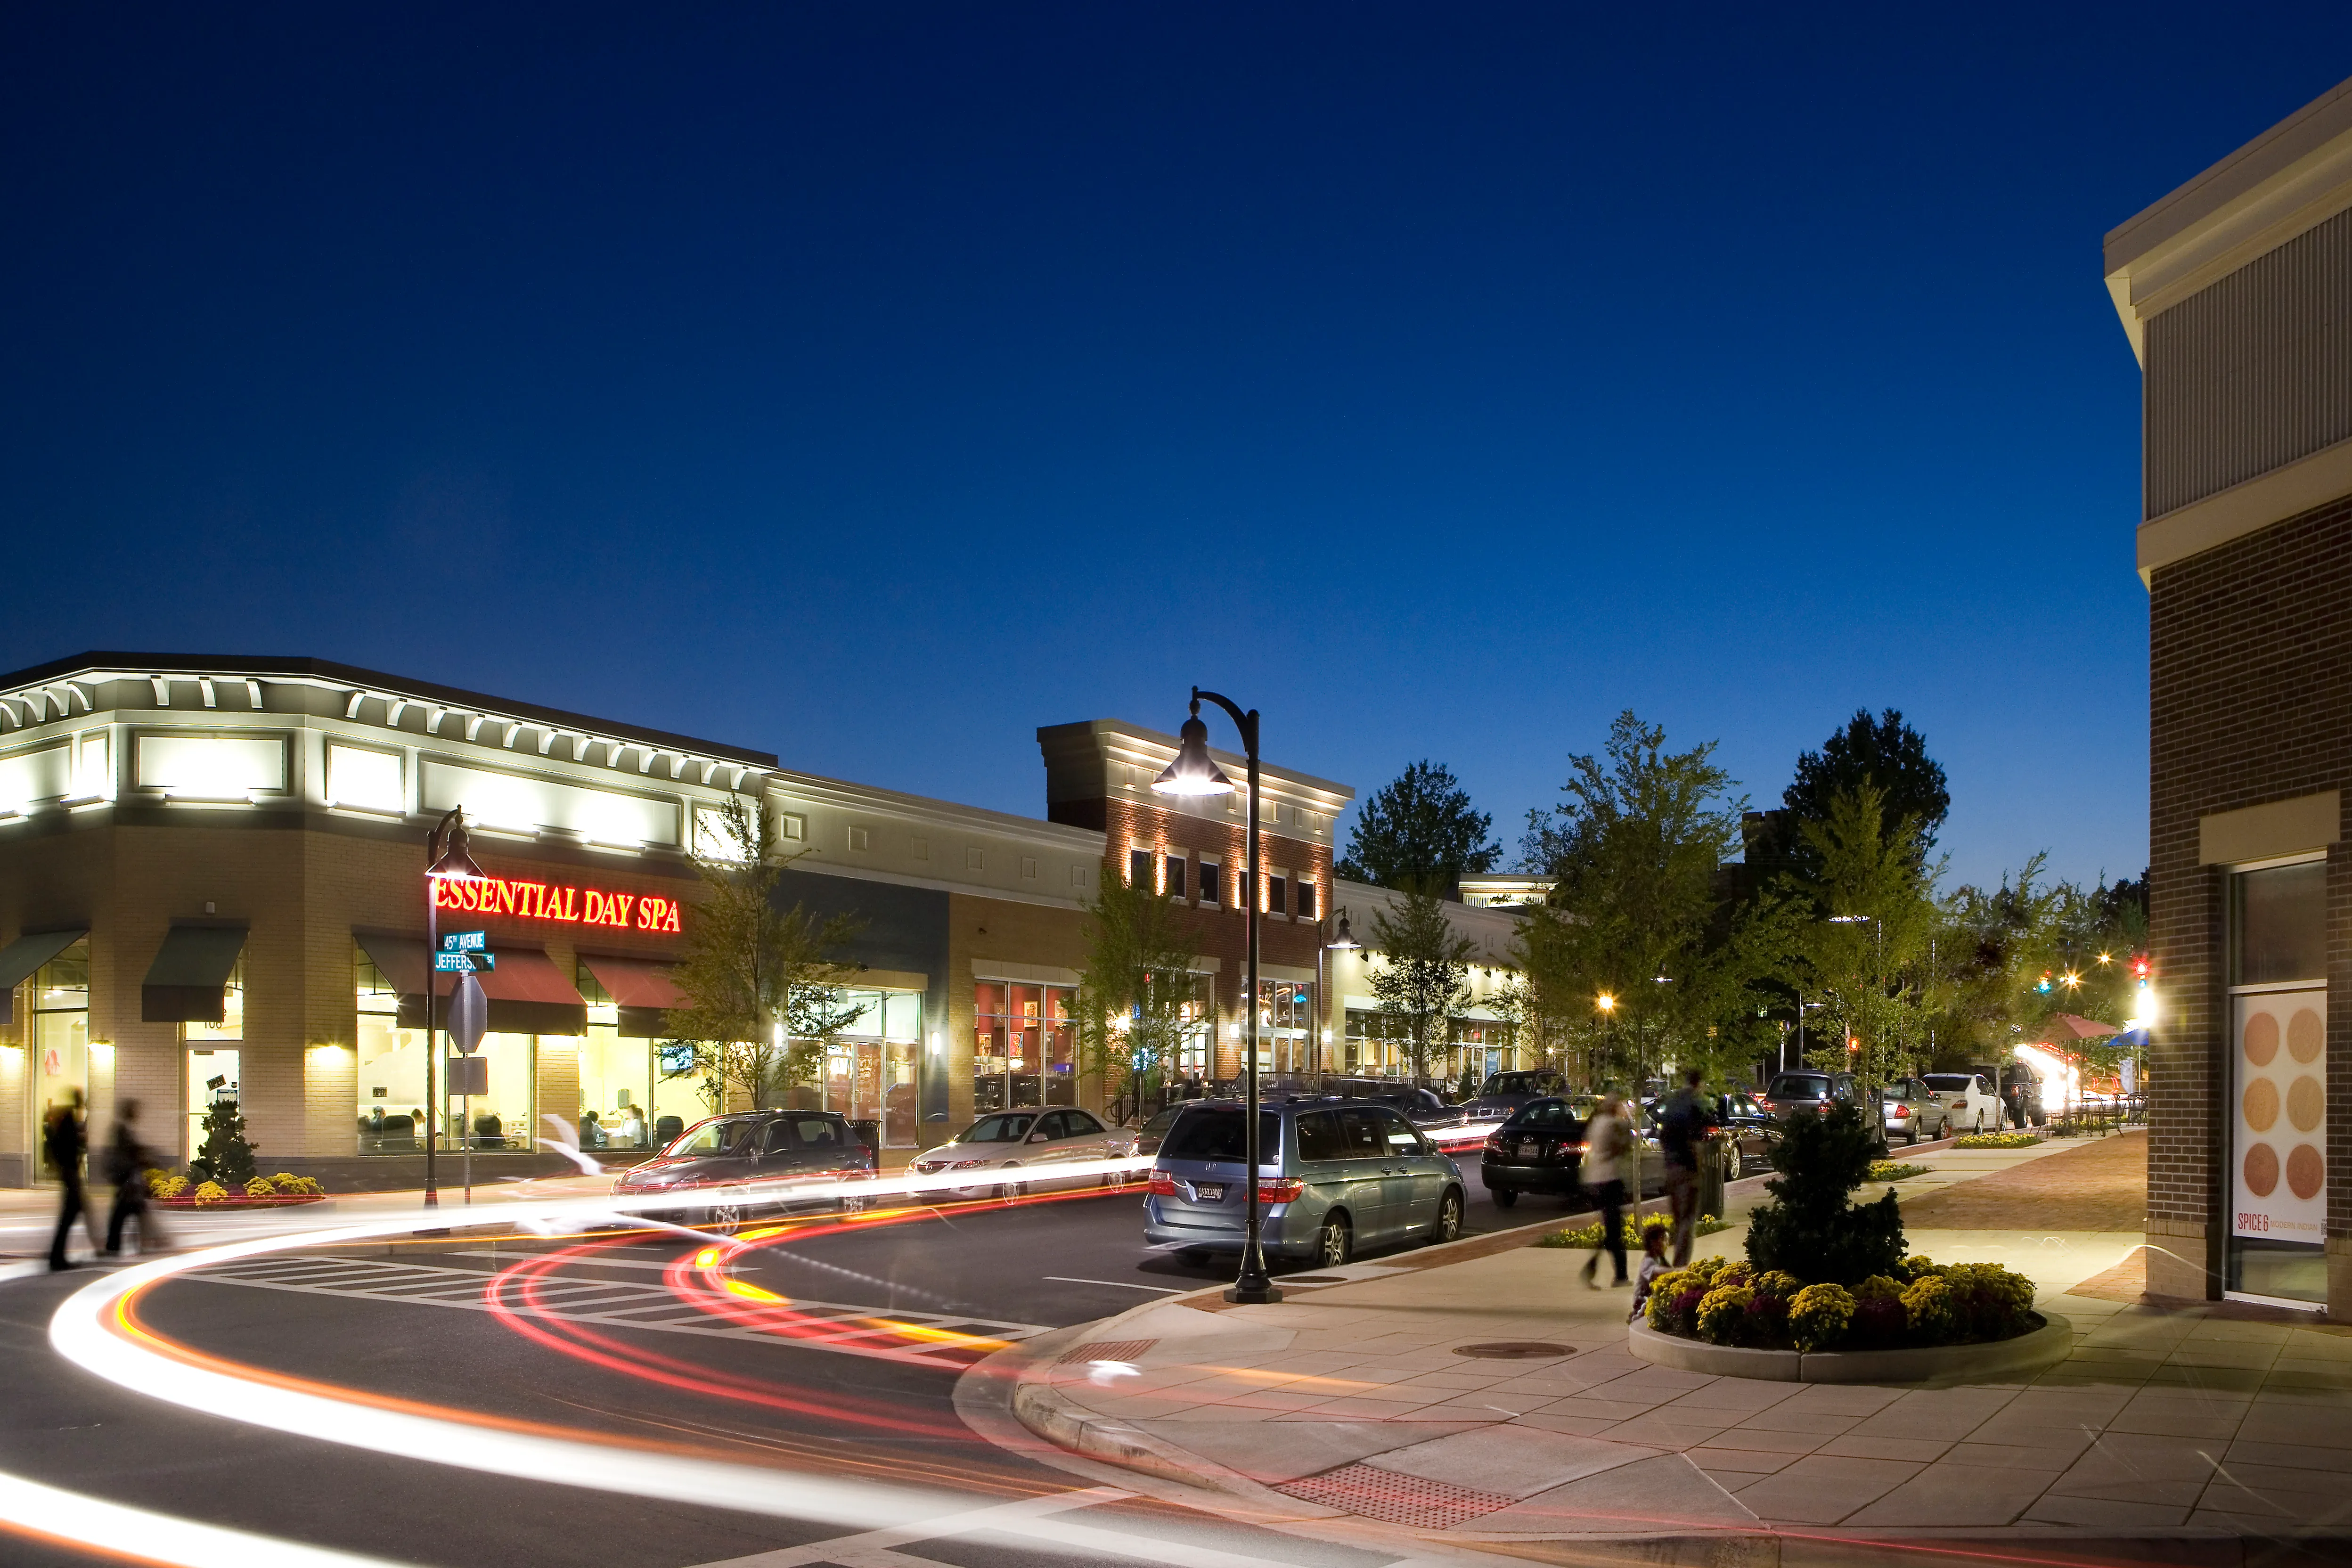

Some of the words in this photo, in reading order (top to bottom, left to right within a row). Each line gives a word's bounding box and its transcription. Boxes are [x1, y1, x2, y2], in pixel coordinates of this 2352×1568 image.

[435, 877, 579, 921] ESSENTIAL
[583, 891, 634, 926] DAY
[638, 897, 680, 932] SPA
[459, 933, 483, 949] AVENUE
[436, 954, 483, 970] JEFFERSON
[487, 956, 493, 964] ST
[208, 1076, 224, 1089] OPEN
[374, 1087, 386, 1096] OPEN
[2238, 1212, 2262, 1231] SPICE
[2263, 1215, 2269, 1232] 6
[2270, 1220, 2295, 1229] MODERN
[2297, 1223, 2318, 1231] INDIAN
